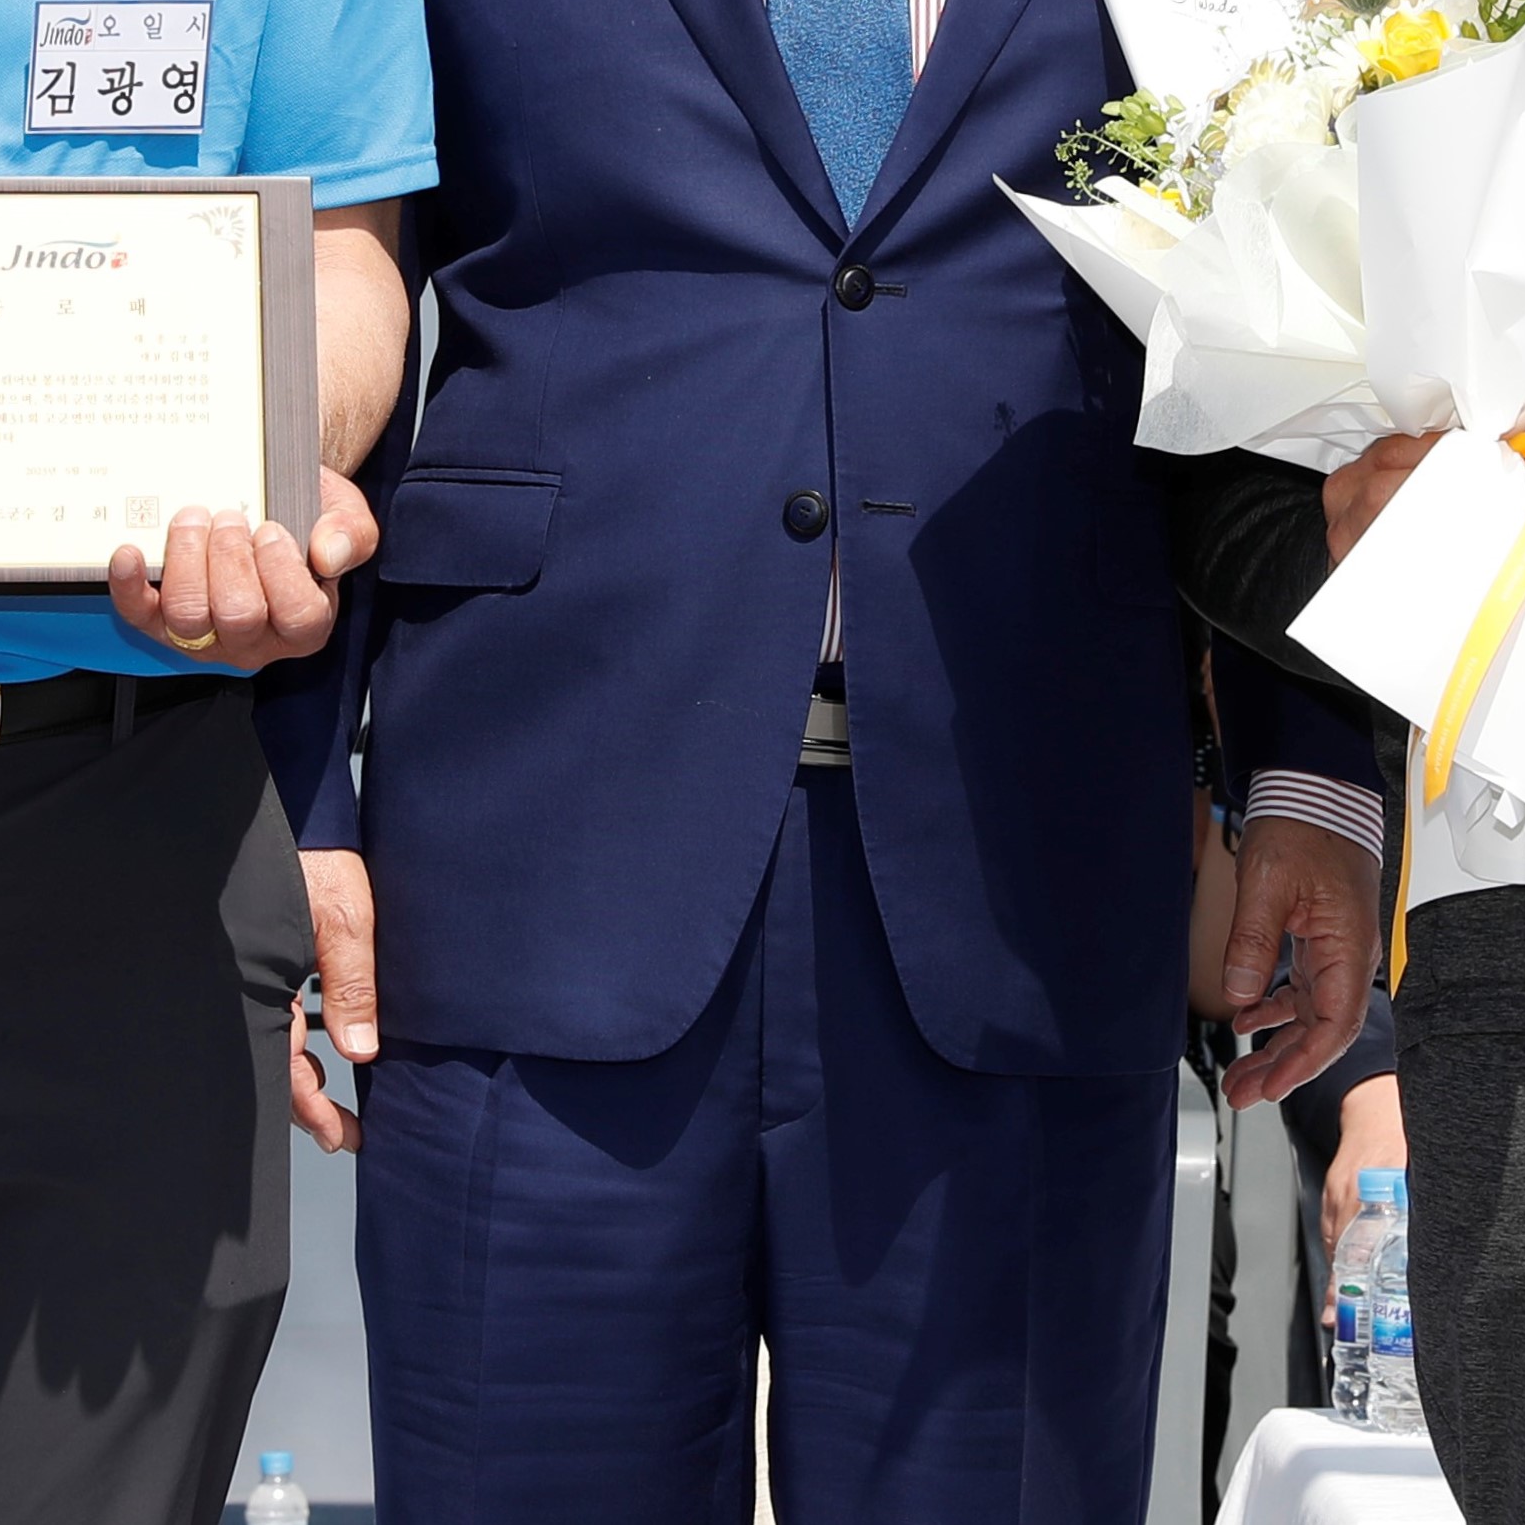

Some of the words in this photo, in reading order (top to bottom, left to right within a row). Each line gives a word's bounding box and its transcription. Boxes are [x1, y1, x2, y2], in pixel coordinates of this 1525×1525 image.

[40, 21, 84, 48] Jindo
[36, 60, 200, 117] 김광영
[1, 244, 106, 272] Jindo
